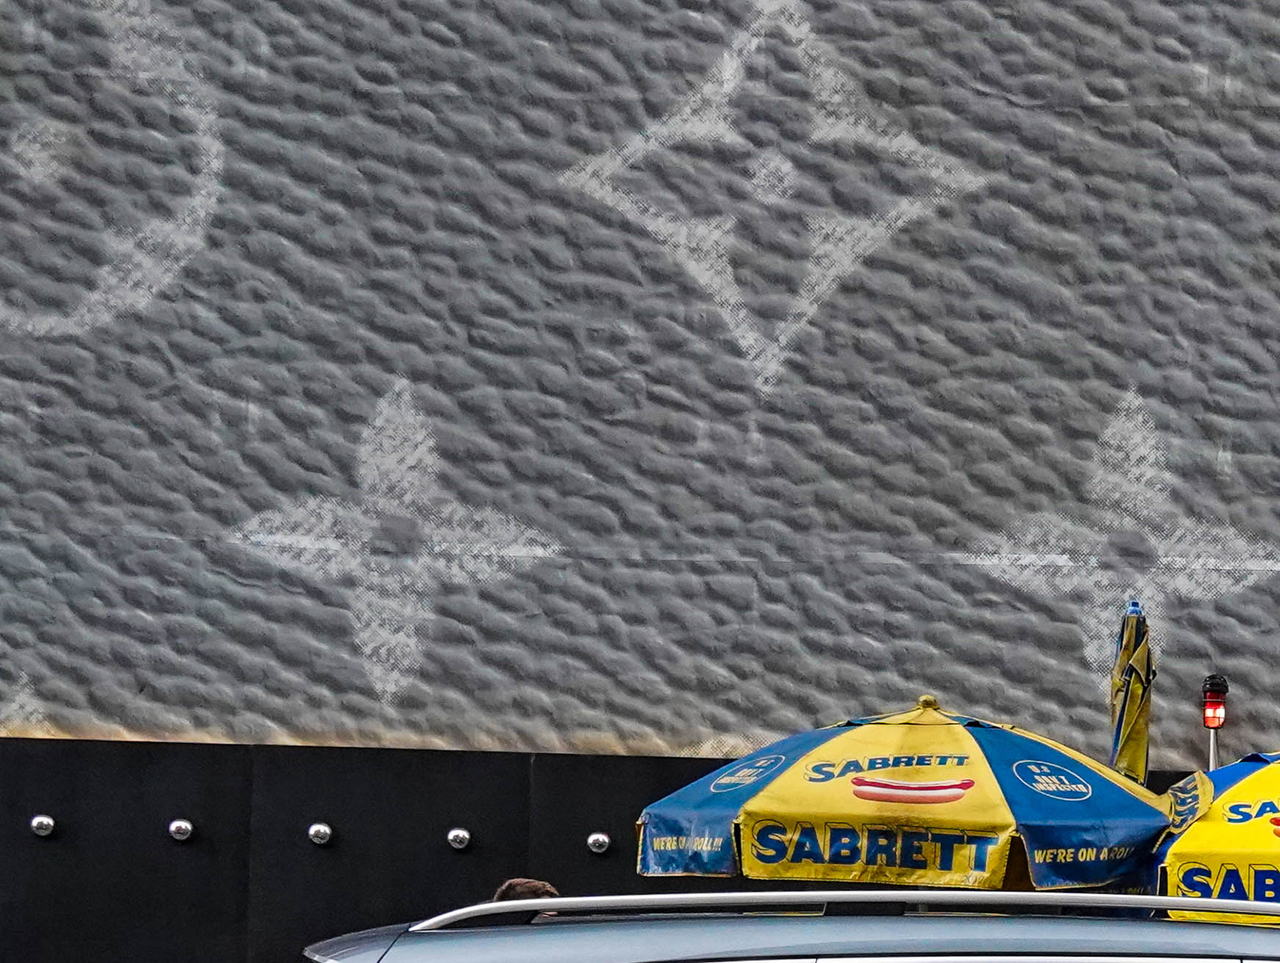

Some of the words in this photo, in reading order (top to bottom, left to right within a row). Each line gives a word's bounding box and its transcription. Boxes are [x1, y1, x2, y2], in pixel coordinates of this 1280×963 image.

[804, 754, 969, 783] SABRETT
[752, 819, 999, 872] SABRETT
[1034, 848, 1075, 864] WE'RE
[1078, 847, 1097, 862] ON
[1099, 847, 1108, 861] A
